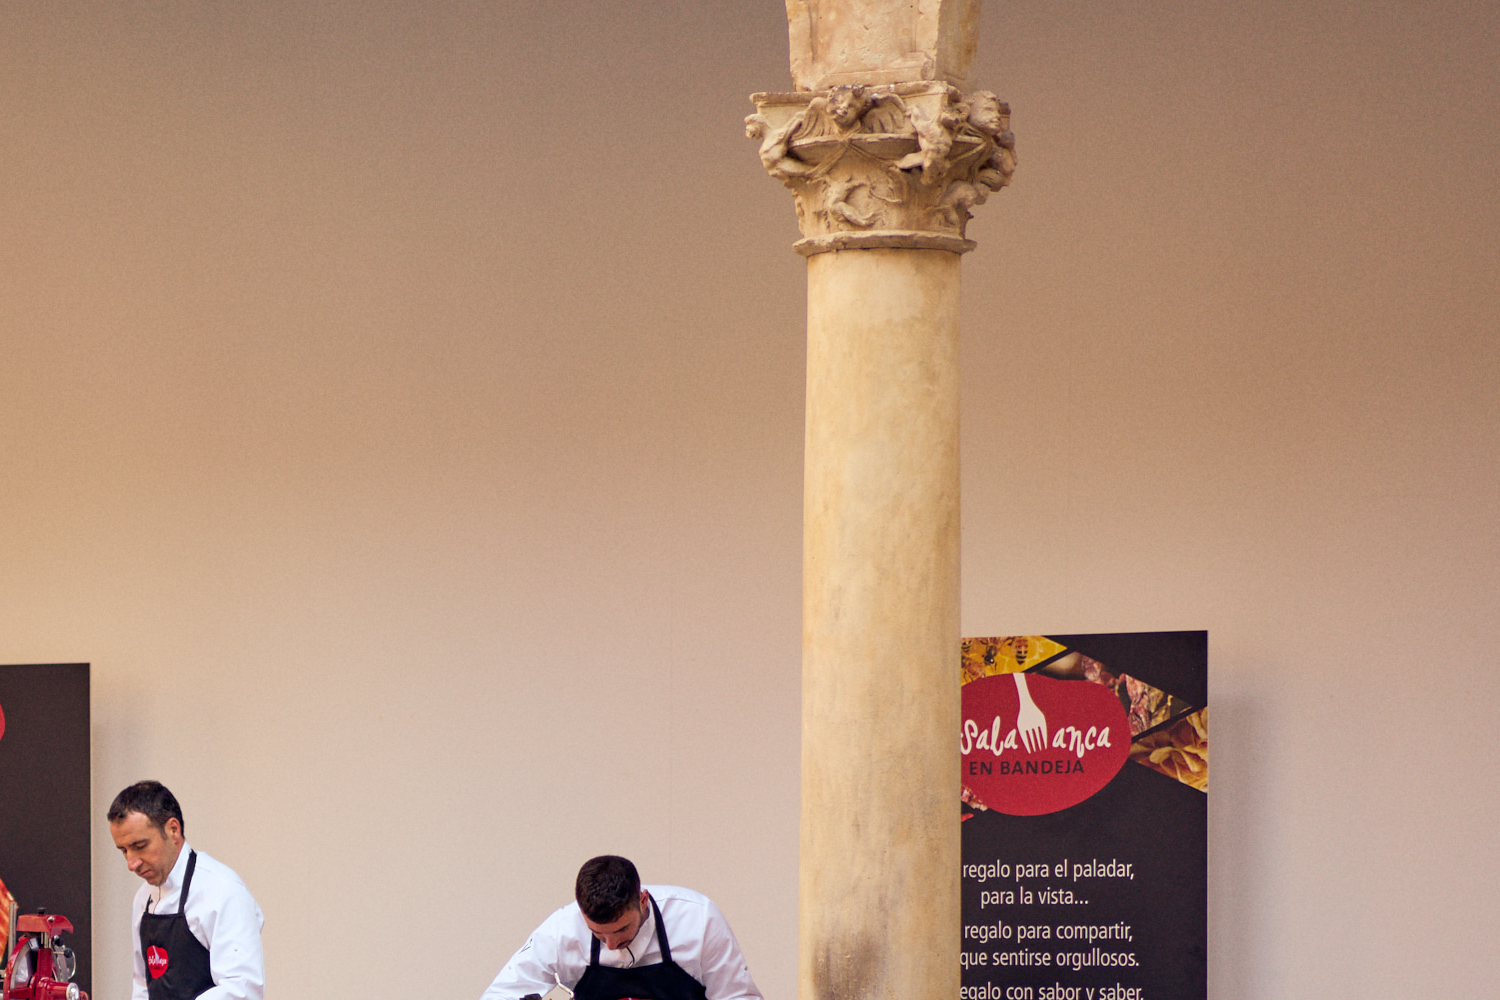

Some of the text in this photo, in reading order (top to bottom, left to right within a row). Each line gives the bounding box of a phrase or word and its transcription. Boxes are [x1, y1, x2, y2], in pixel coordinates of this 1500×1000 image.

[969, 760, 1085, 776] EN BANDEJA
[963, 859, 1135, 882] regalo para el paladar,
[980, 886, 1089, 909] para la vista...
[964, 921, 1133, 943] regalo para compartir,
[960, 948, 1139, 970] que sentirse orgullosos.
[1006, 986, 1033, 1000] con
[1038, 982, 1081, 1000] sabor
